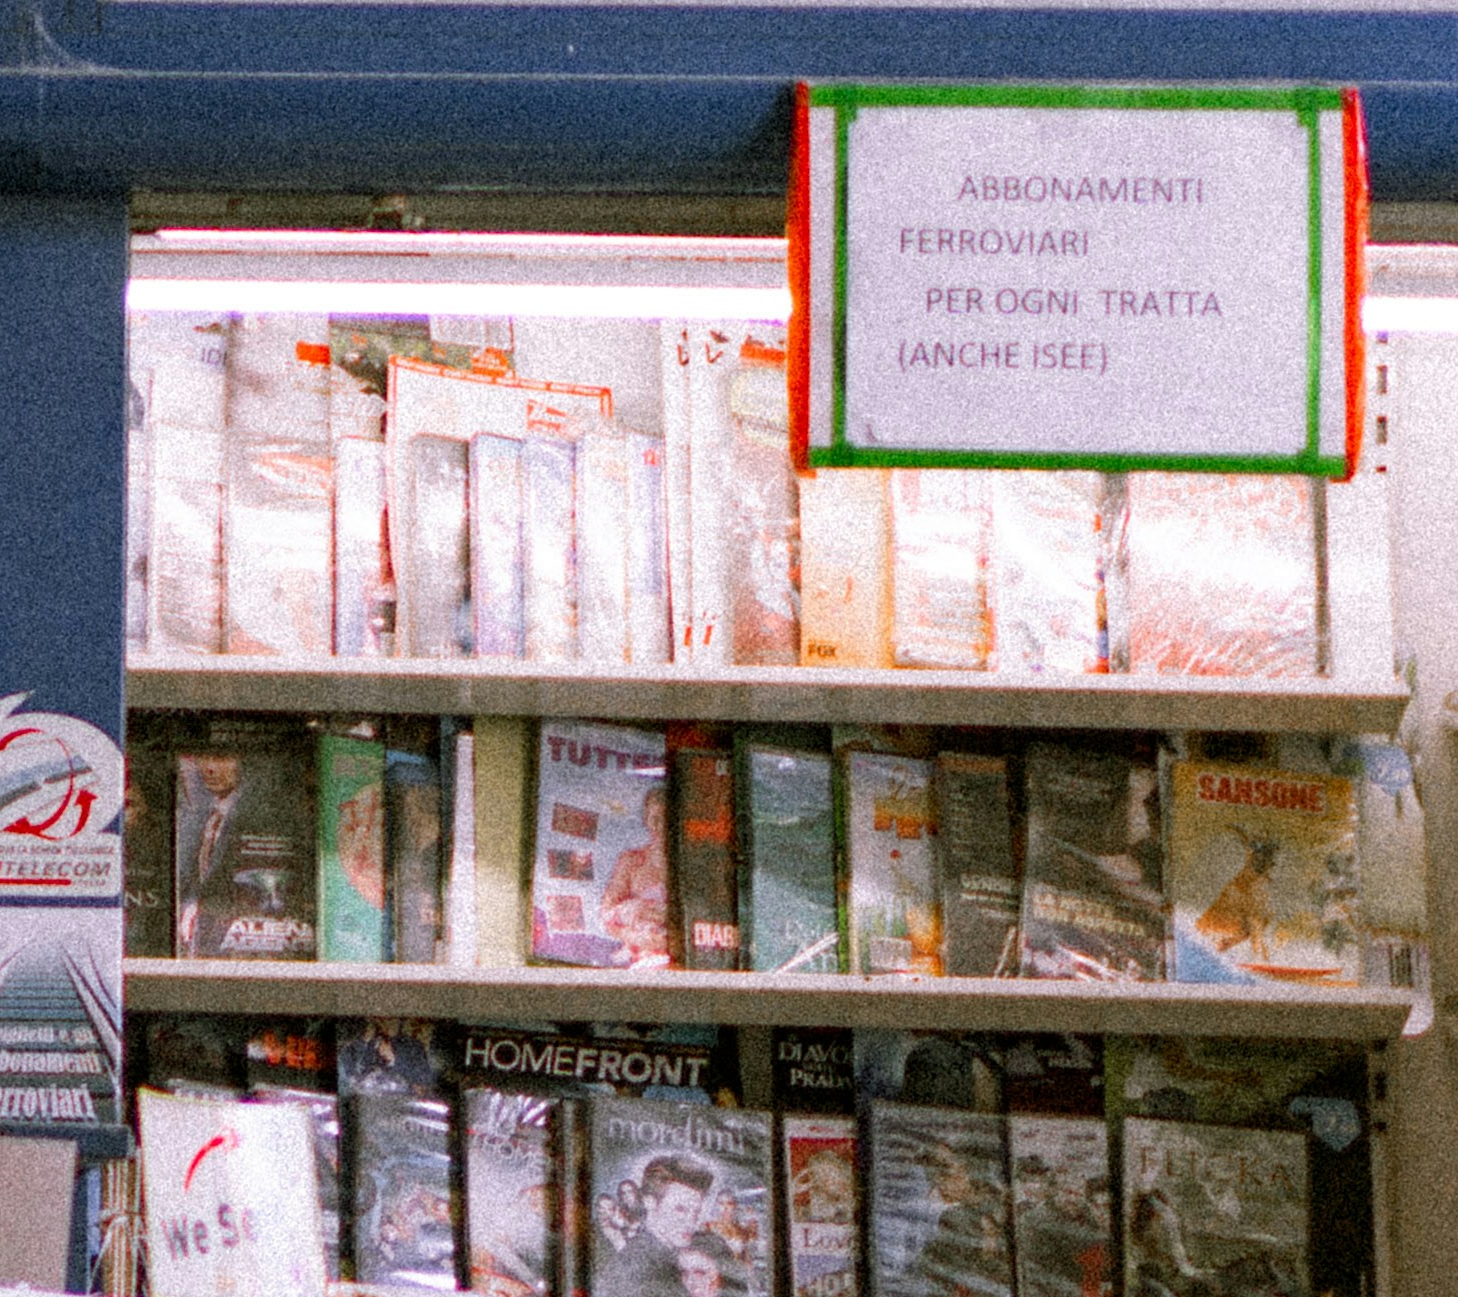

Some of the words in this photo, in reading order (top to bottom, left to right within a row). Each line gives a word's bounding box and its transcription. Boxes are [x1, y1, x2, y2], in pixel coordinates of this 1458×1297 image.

[957, 174, 1205, 205] ABBONAMENTI
[899, 227, 1090, 257] FERROVIARI
[926, 286, 982, 314] PER
[995, 288, 1080, 316] OGNI
[1100, 289, 1223, 318] TRATTA
[897, 339, 1020, 371] (ANCHE
[1032, 342, 1109, 374] ISEE)
[1197, 773, 1324, 815] SANSONE
[4, 860, 112, 879] TELECOM
[465, 1038, 709, 1087] HOMEFRONT
[159, 1211, 210, 1264] We
